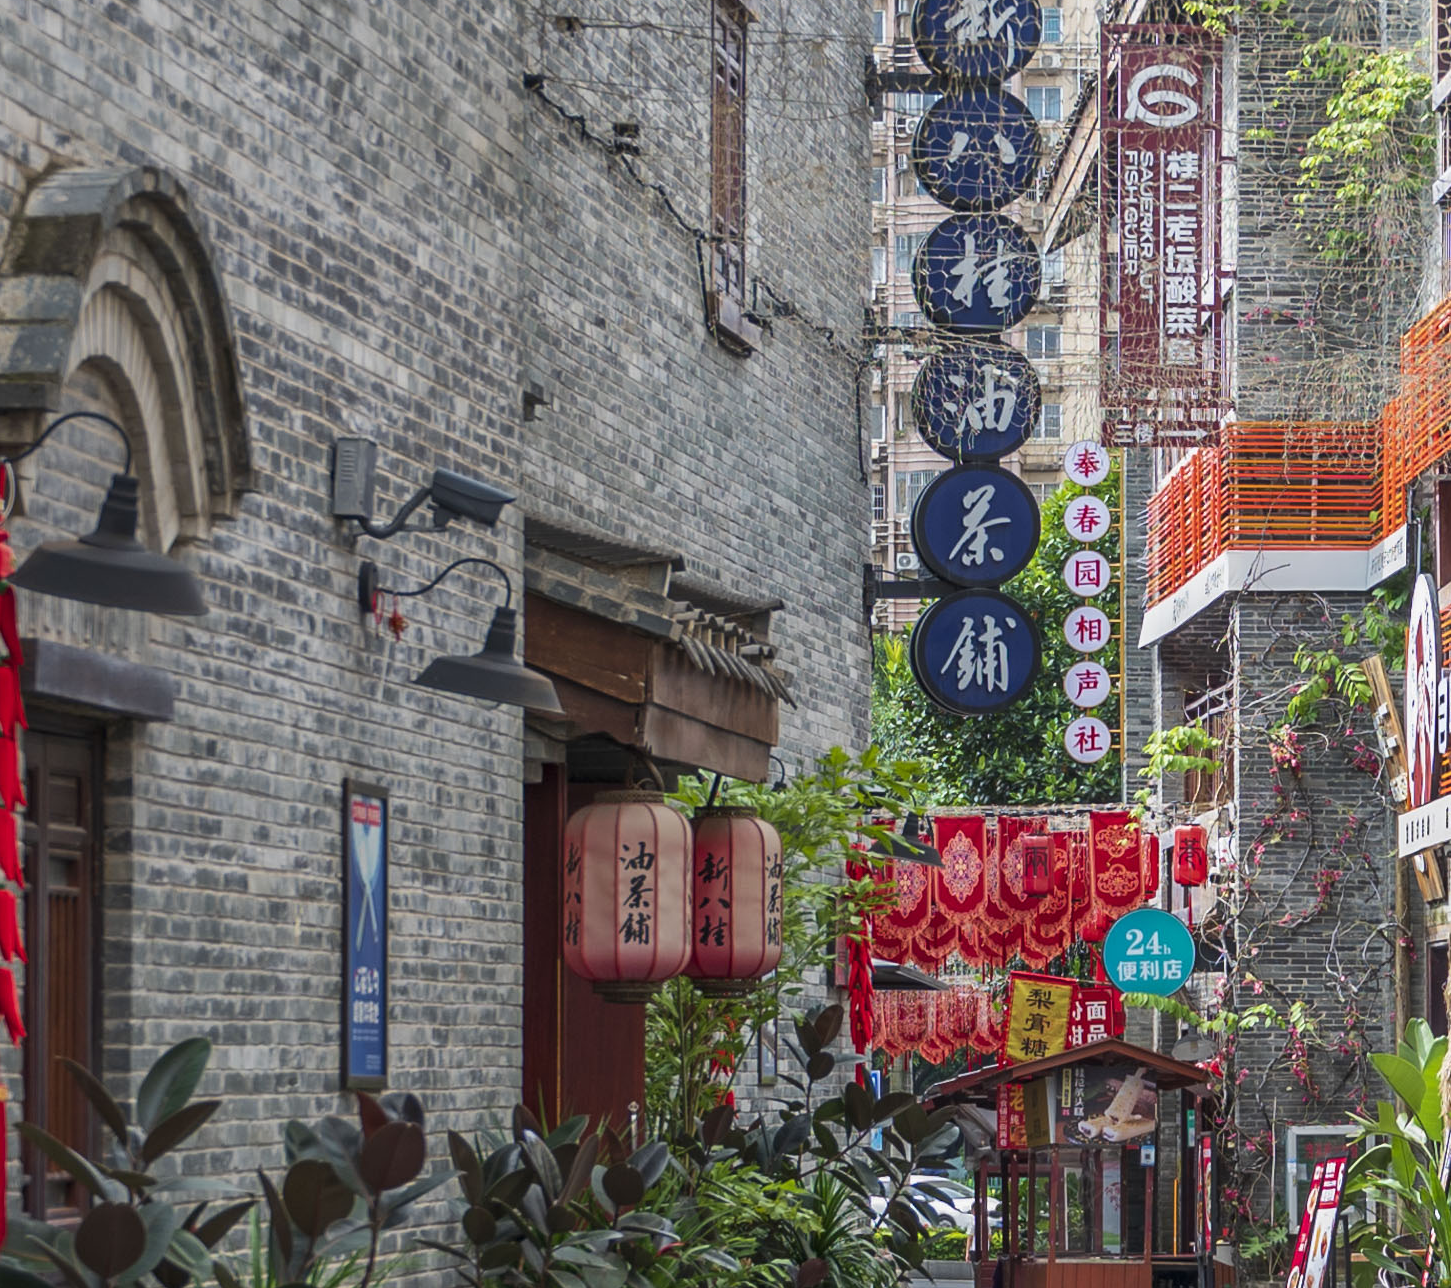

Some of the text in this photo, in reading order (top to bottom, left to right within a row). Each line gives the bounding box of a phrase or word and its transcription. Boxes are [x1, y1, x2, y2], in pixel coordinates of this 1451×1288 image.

[1124, 151, 1139, 203] FISH
[1140, 151, 1154, 305] SAUERKRUT
[1073, 450, 1104, 755] 奉春园相声社
[698, 852, 730, 946] 新八桂
[1116, 959, 1183, 982] 便利店
[1125, 928, 1171, 956] 24h
[1020, 988, 1055, 1058] 梨膏糖
